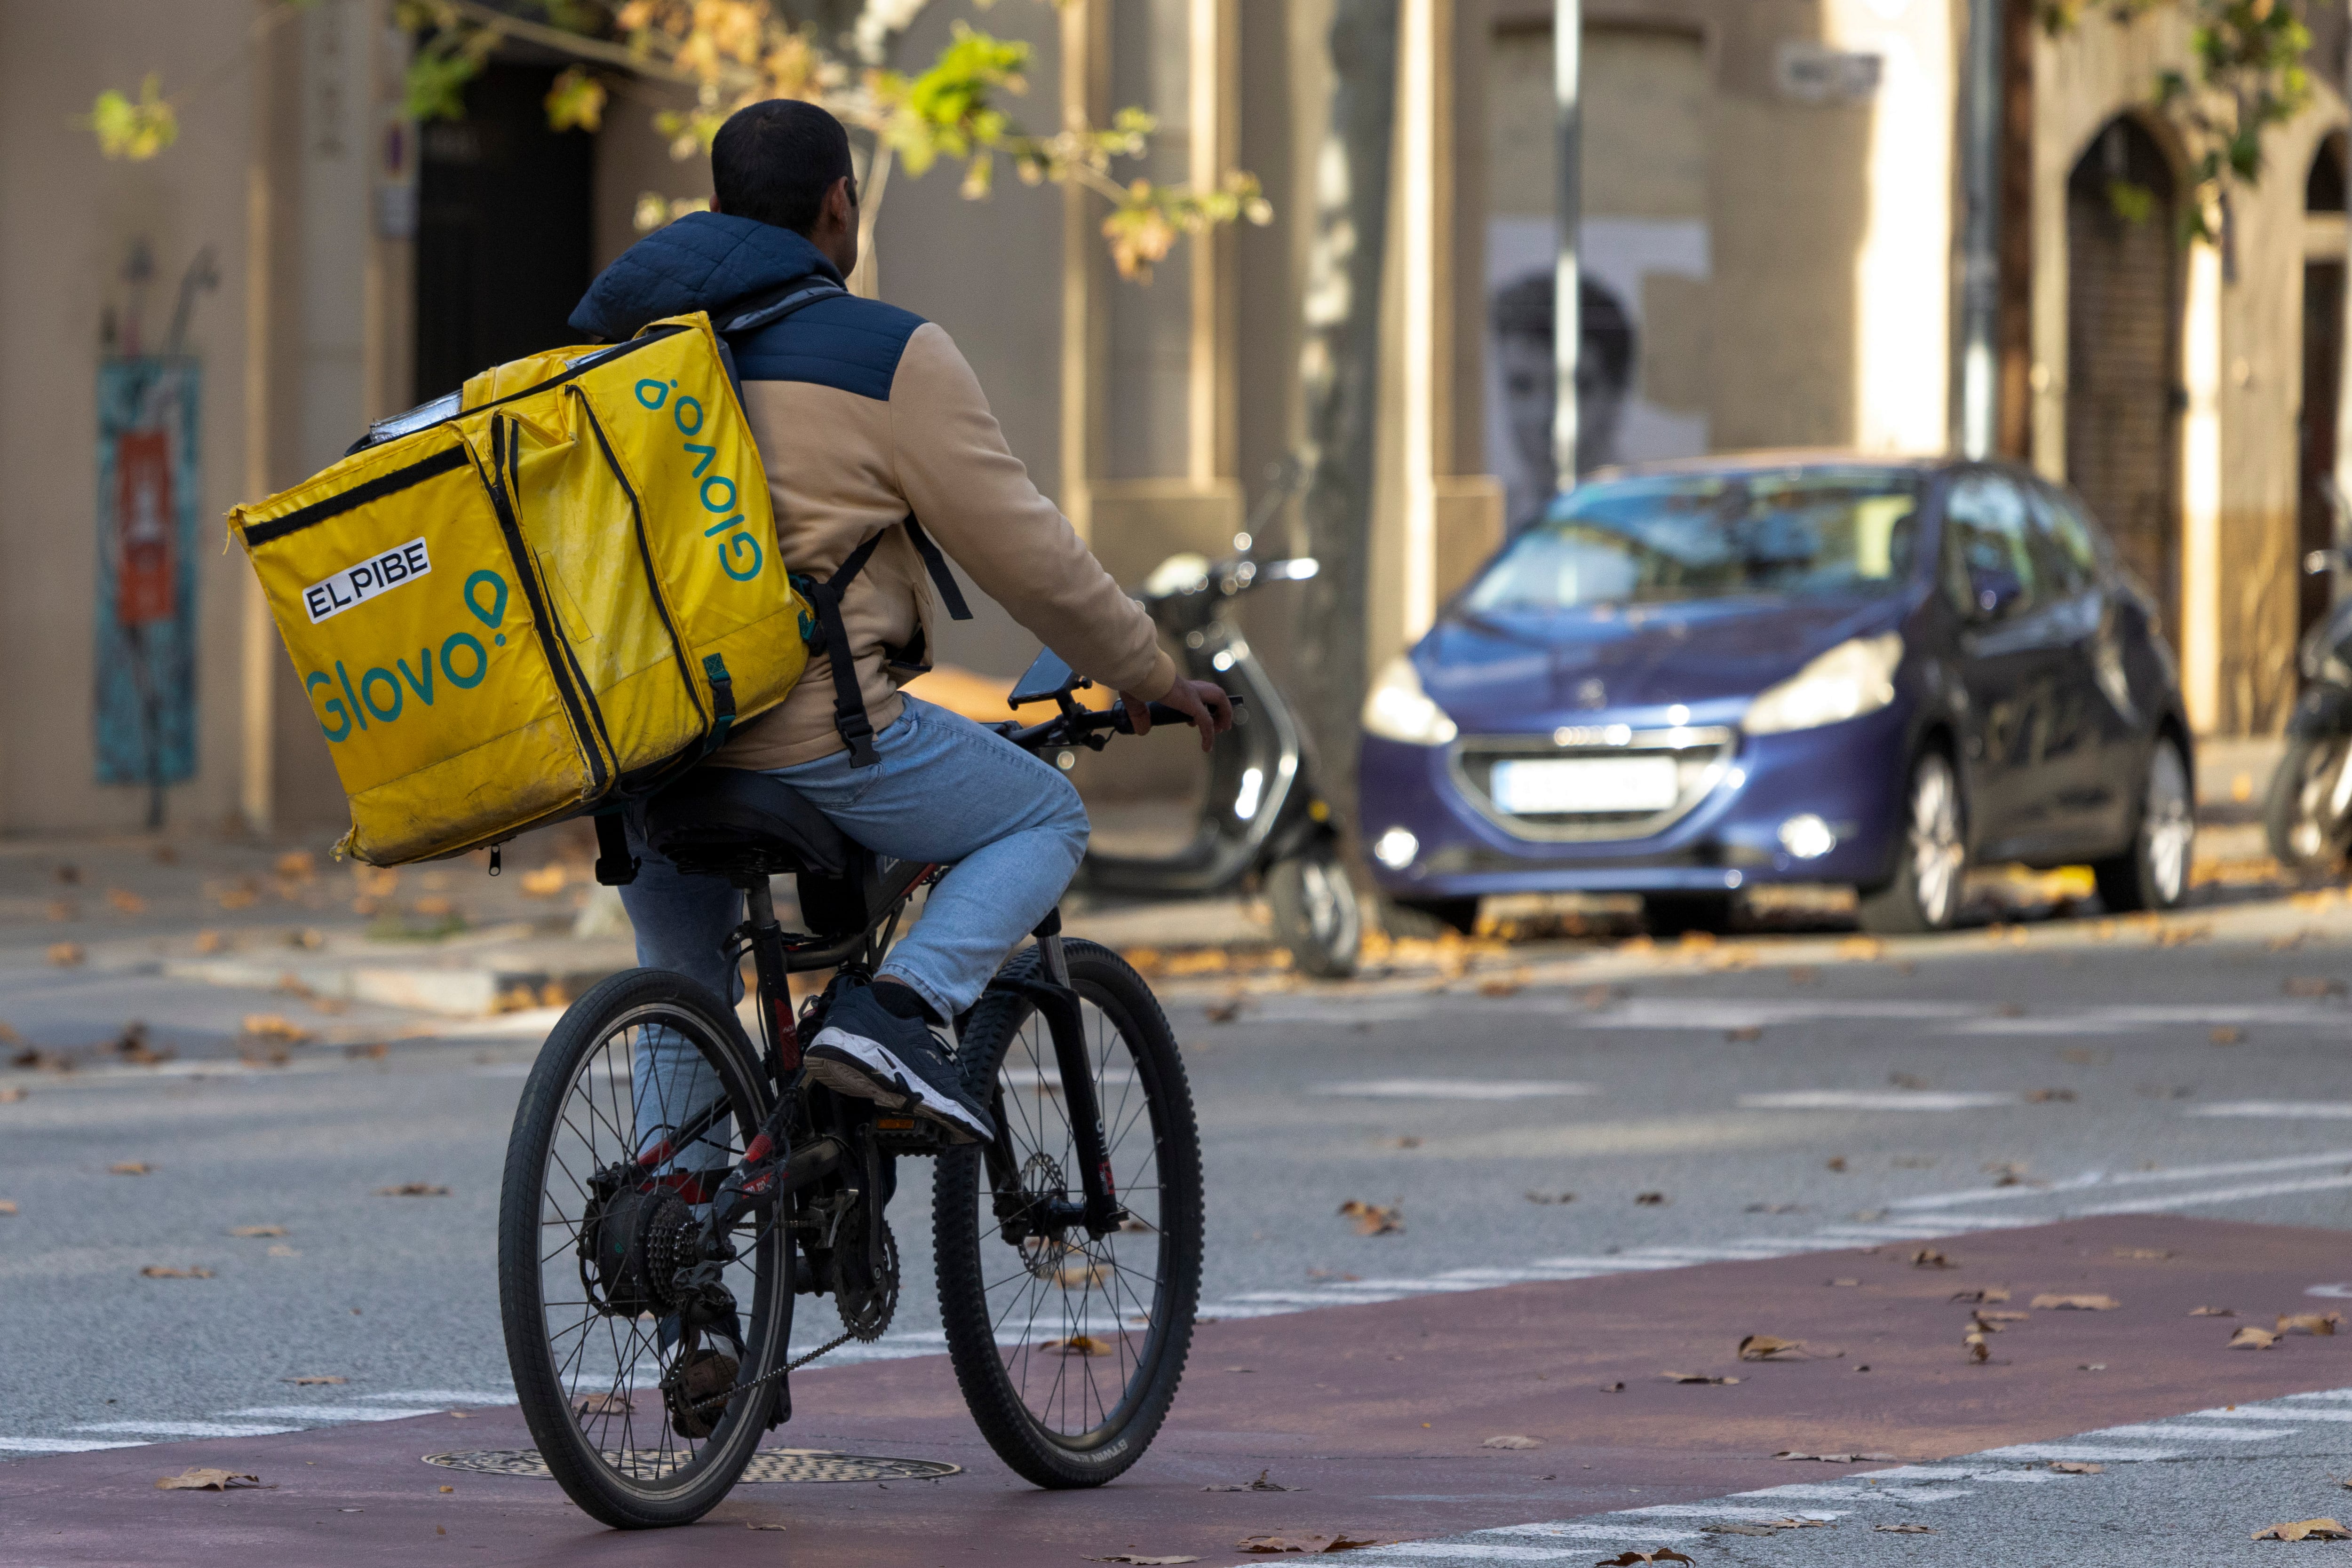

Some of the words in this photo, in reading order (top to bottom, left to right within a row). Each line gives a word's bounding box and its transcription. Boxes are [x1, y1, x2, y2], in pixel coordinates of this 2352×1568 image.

[675, 396, 763, 581] Glovo
[306, 583, 352, 618] EL
[348, 542, 428, 598] PIBE
[306, 632, 487, 743] Glovo
